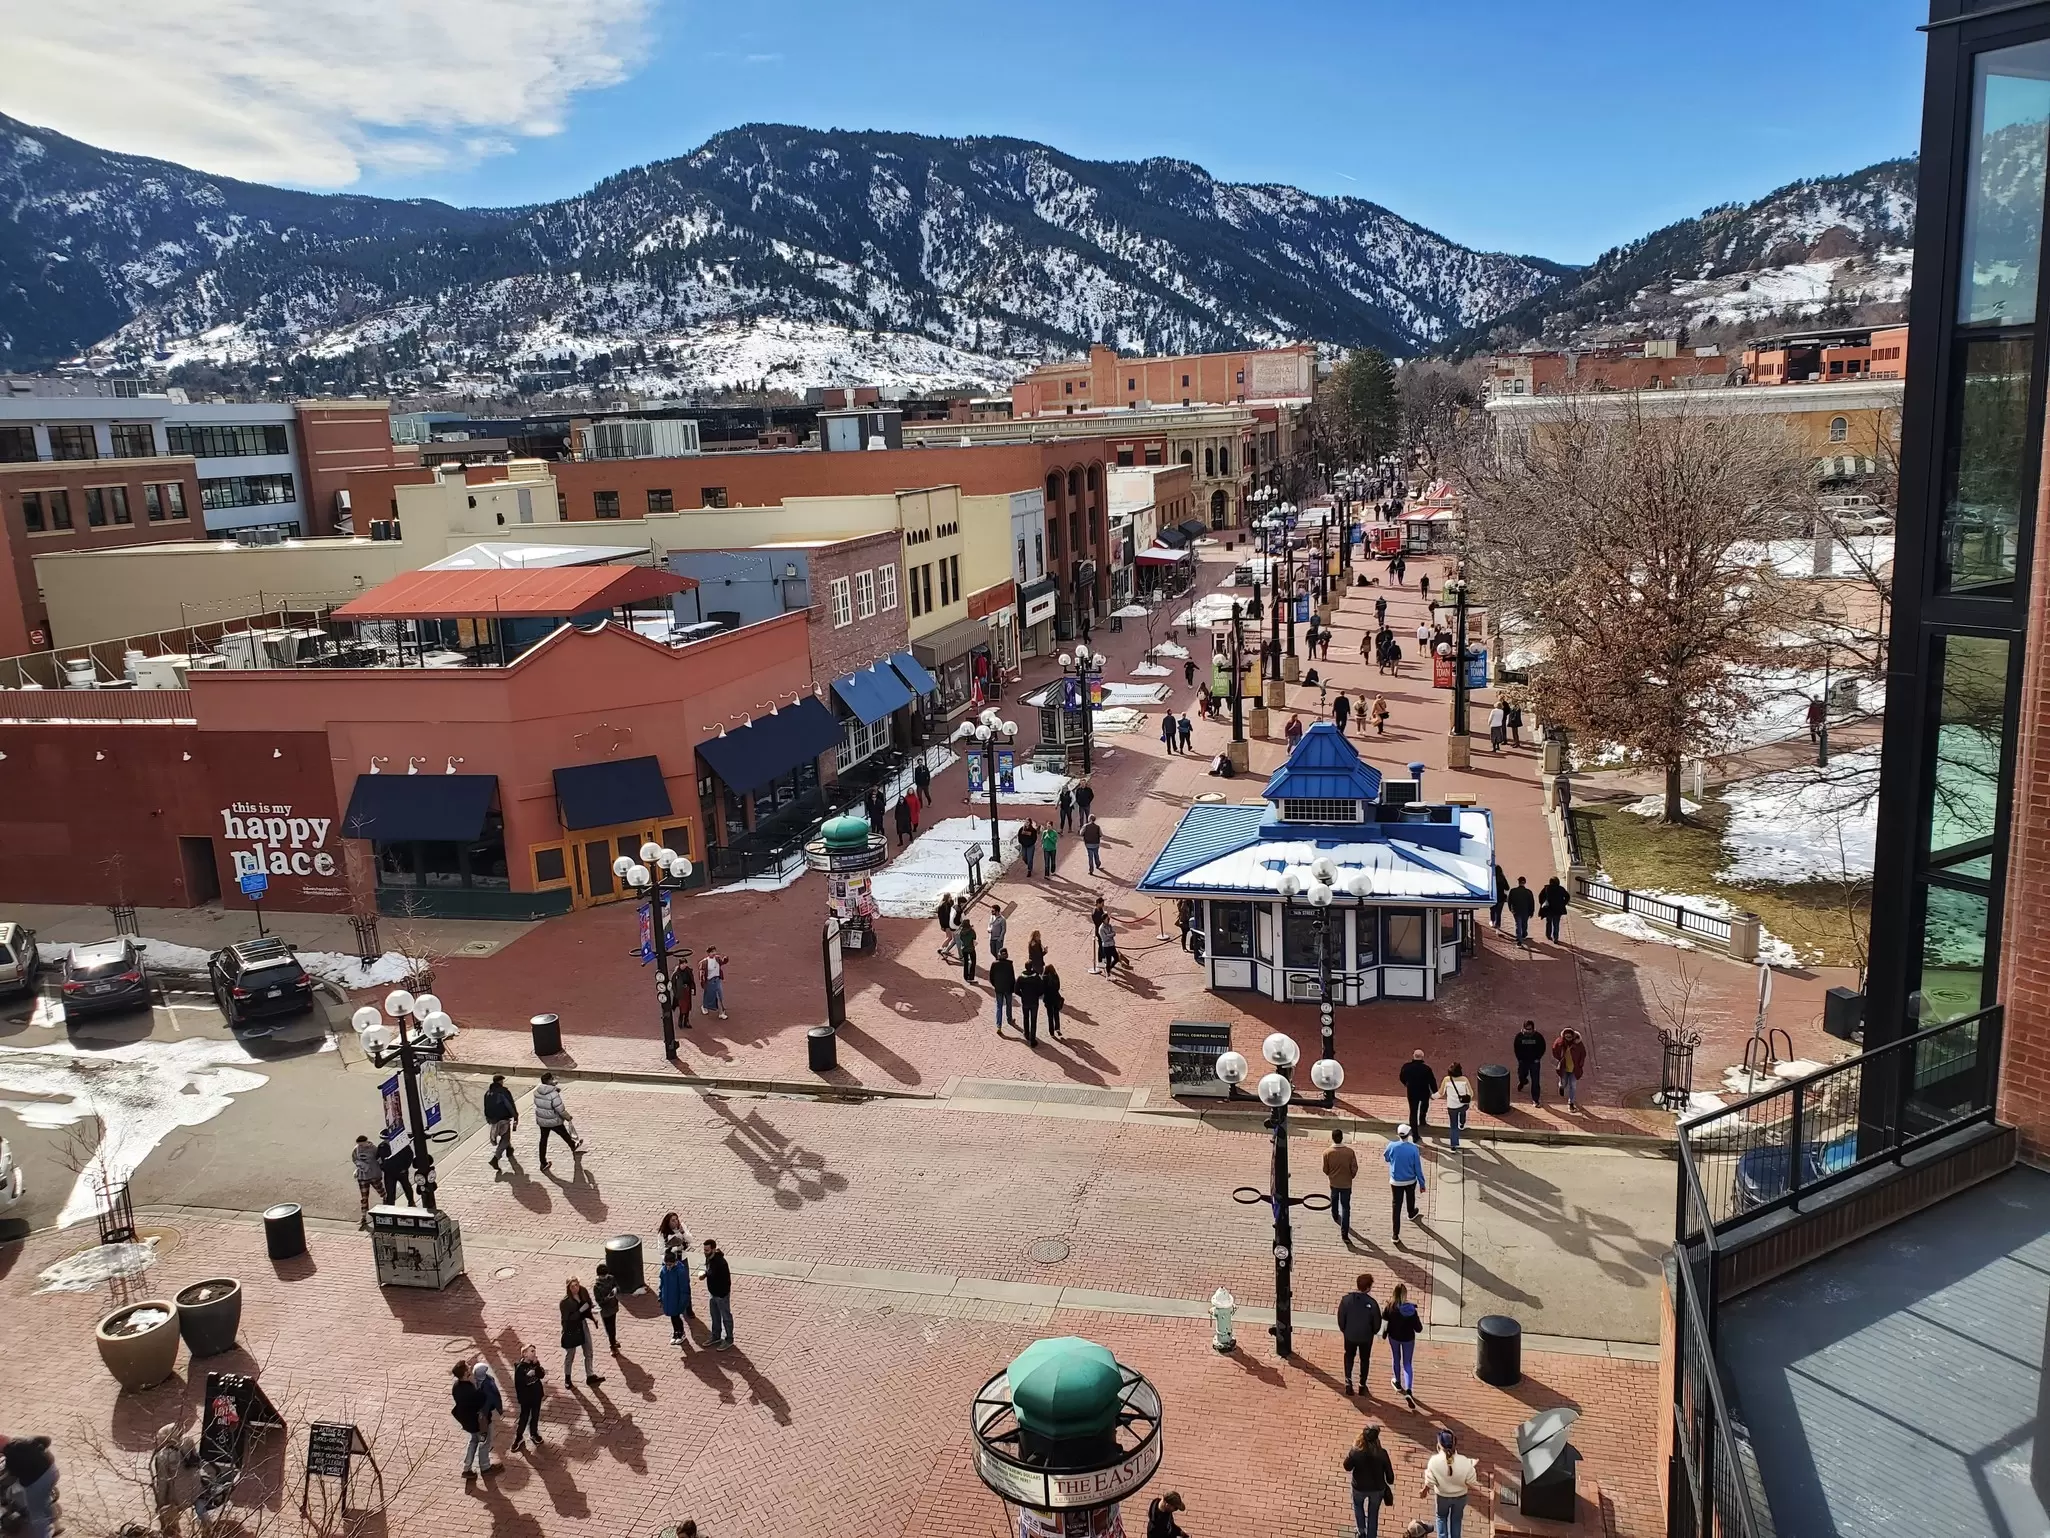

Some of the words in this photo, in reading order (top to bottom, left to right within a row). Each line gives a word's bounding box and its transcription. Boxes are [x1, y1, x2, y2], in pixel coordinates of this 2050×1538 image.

[1436, 668, 1450, 677] TOWN
[1470, 668, 1485, 677] TOWN
[232, 802, 257, 813] this
[259, 802, 270, 813] is
[272, 805, 292, 816] my
[220, 808, 331, 849] happy
[230, 842, 337, 882] place
[1023, 1471, 1041, 1480] DOLLARS
[1054, 1480, 1091, 1493] THE
[1094, 1454, 1142, 1492] EAST
[1055, 1493, 1095, 1501] ADDITIONAL
